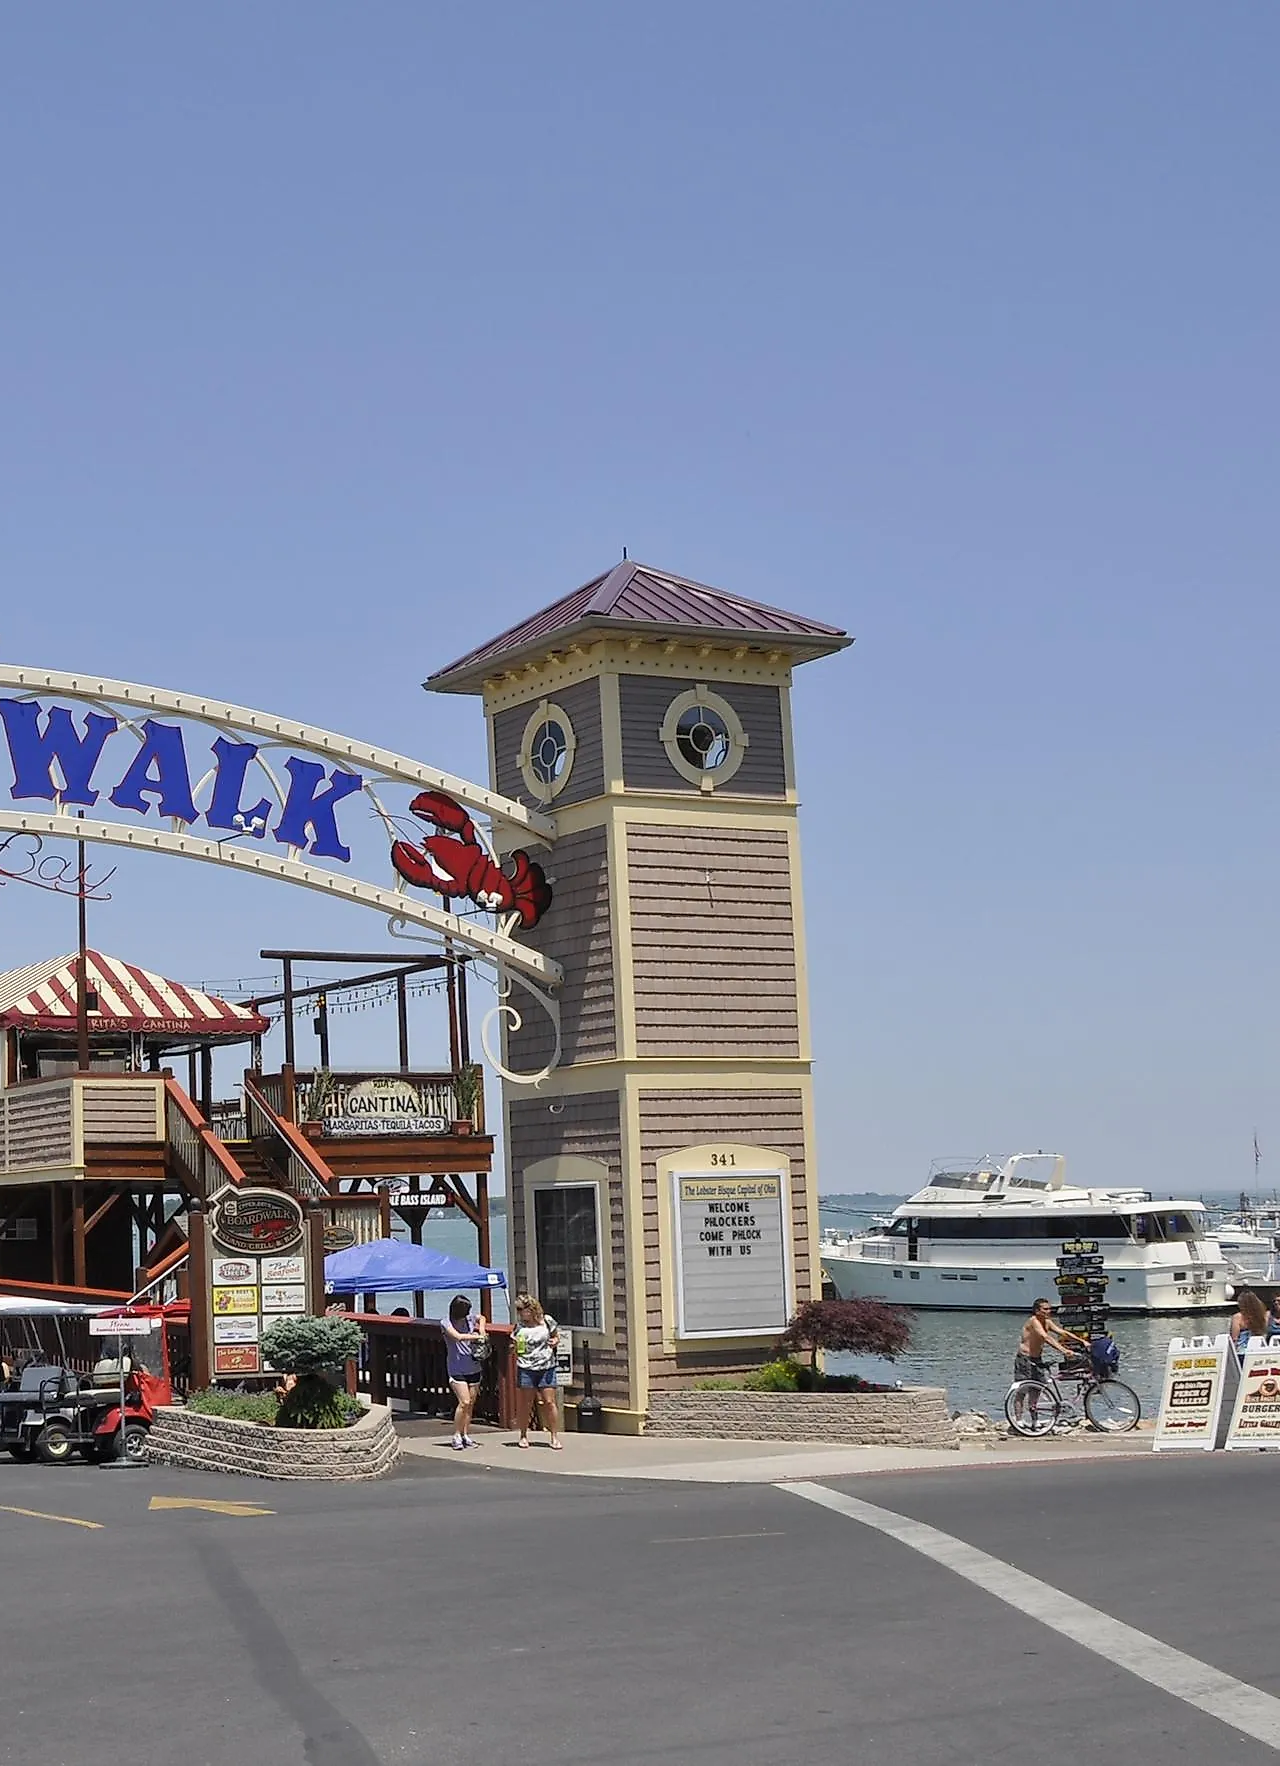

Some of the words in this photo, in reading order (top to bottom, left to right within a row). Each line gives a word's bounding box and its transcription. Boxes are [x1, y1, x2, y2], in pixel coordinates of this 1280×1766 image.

[91, 1018, 129, 1028] RITA'S
[142, 1019, 192, 1030] CANTINA
[349, 1095, 418, 1114] CANTINA
[711, 1154, 736, 1166] 341
[685, 1186, 696, 1195] The
[697, 1186, 717, 1195] Lobster
[400, 1195, 419, 1205] BASS
[420, 1194, 446, 1205] ISLAND
[708, 1202, 750, 1213] WELCOME
[227, 1209, 291, 1226] BOARDWALK
[704, 1216, 756, 1227] PHLOCKERS
[699, 1231, 724, 1241] COME
[732, 1230, 761, 1240] PHLOCK
[708, 1246, 732, 1256] WITH
[740, 1245, 752, 1255] US
